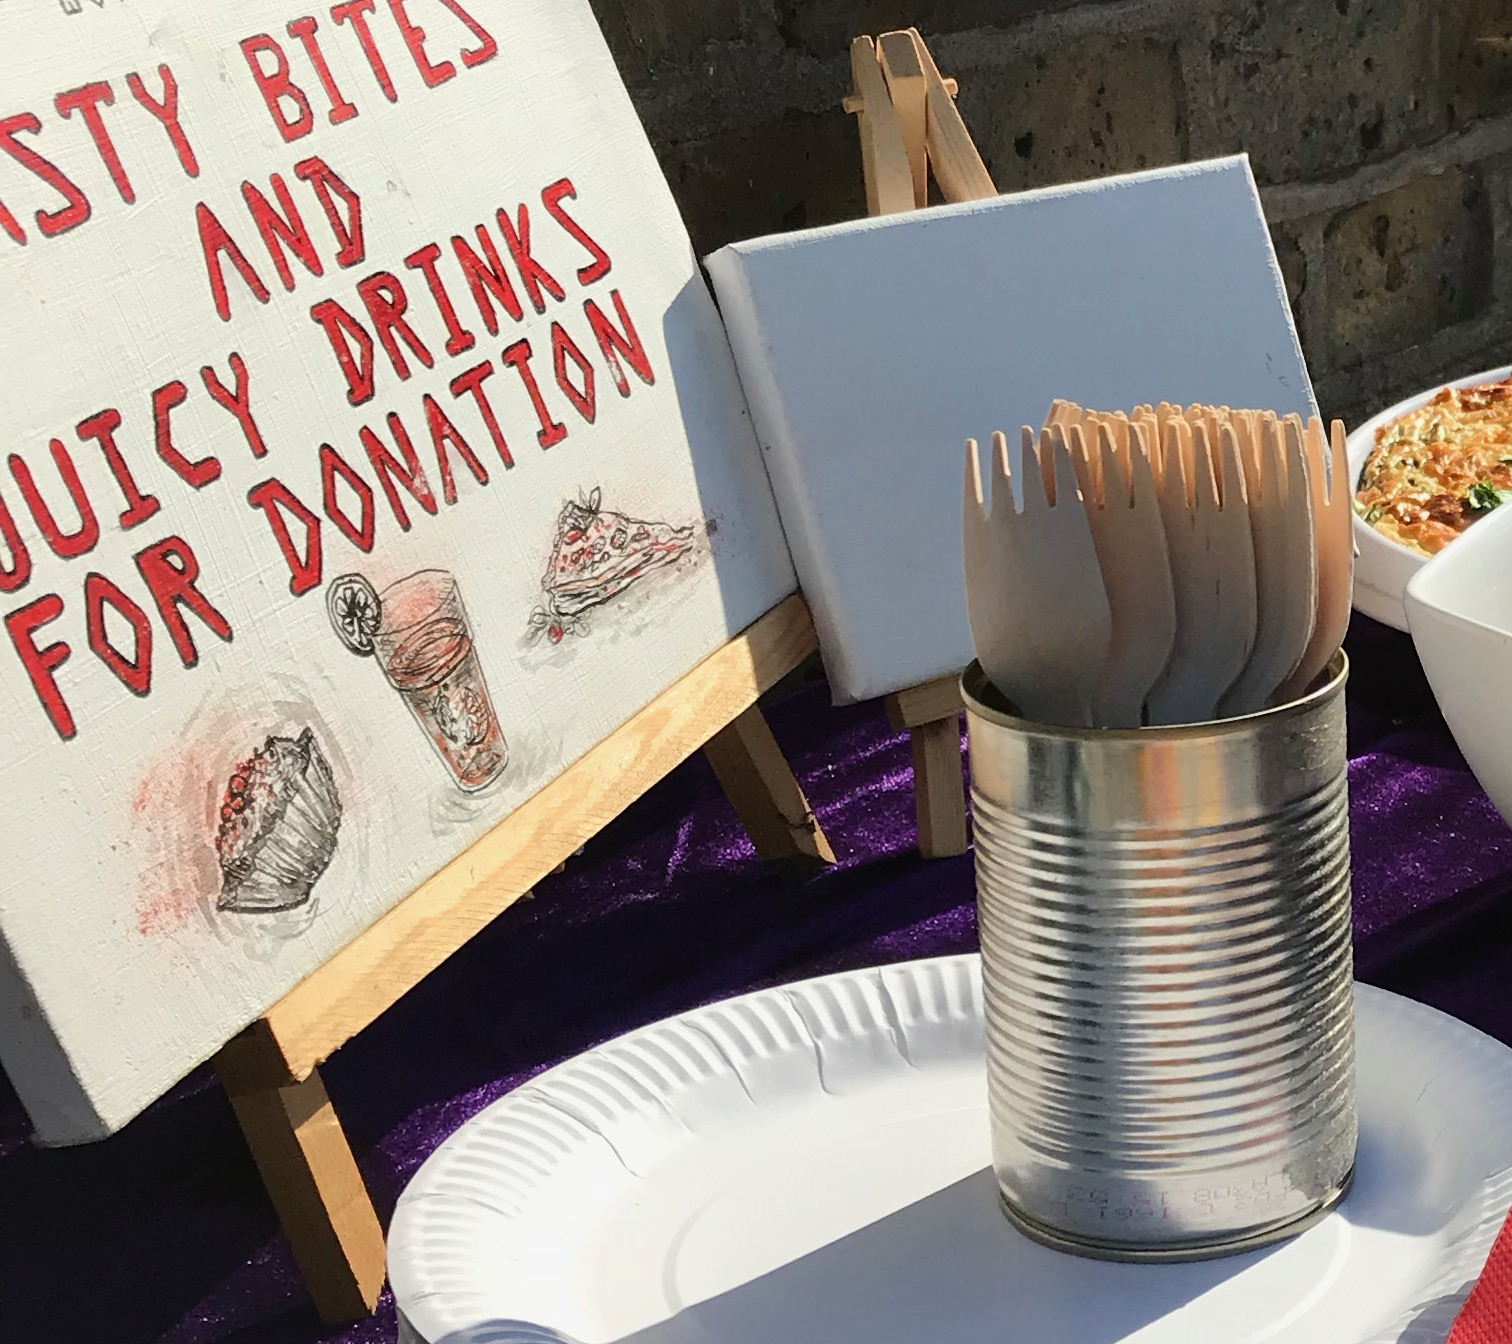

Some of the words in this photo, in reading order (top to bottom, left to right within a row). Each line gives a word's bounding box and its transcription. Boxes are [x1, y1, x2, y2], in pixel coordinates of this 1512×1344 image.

[0, 64, 200, 247] STY
[196, 156, 365, 322] AND
[310, 177, 612, 407] DRINKS
[4, 536, 234, 742] FOR
[247, 289, 656, 597] DONATION
